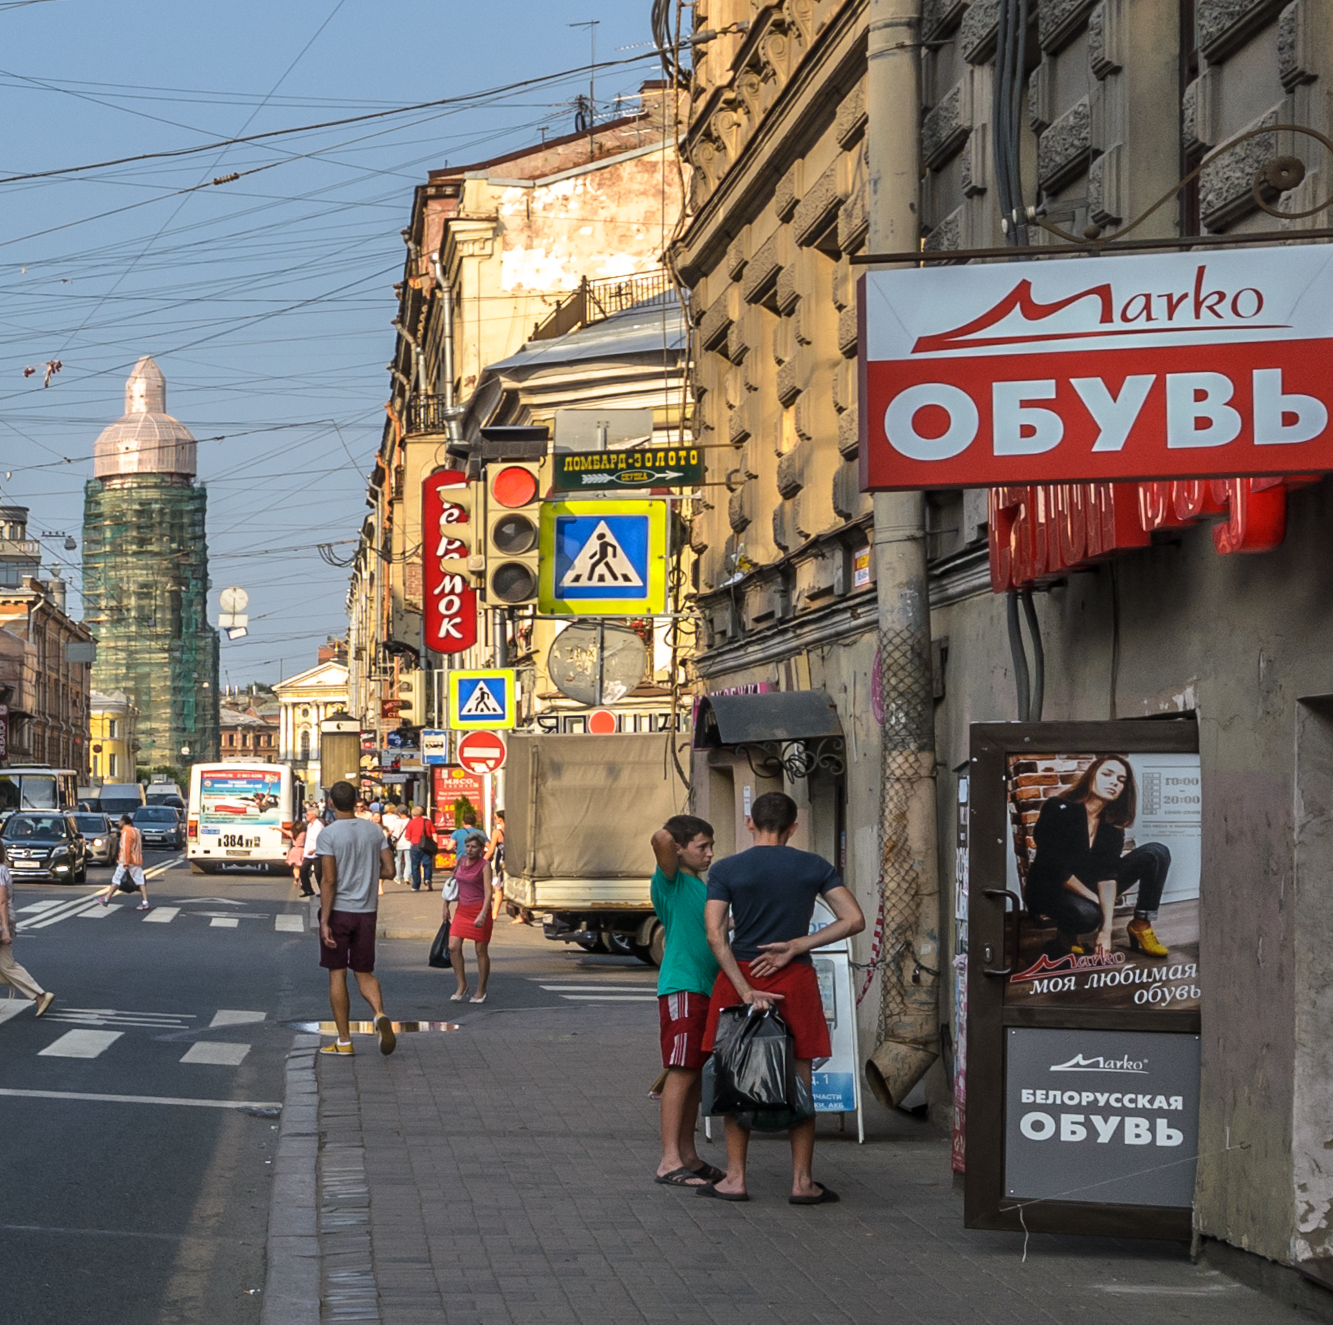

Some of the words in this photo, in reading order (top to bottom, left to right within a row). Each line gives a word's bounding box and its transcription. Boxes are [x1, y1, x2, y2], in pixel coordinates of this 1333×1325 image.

[910, 265, 1267, 354] Marko
[884, 368, 1328, 461] ОБУВЬ
[564, 454, 627, 471] ЛОМБАРД
[634, 450, 698, 467] ЗОЛОТО
[223, 835, 244, 847] 384
[1010, 947, 1125, 982] Marko
[1029, 976, 1076, 994] моя
[1084, 963, 1197, 989] любимая
[1134, 982, 1201, 1006] обувь
[1021, 1089, 1183, 1110] БЕЛОРУССКАЯ
[1020, 1111, 1184, 1147] ОБУВЬ
